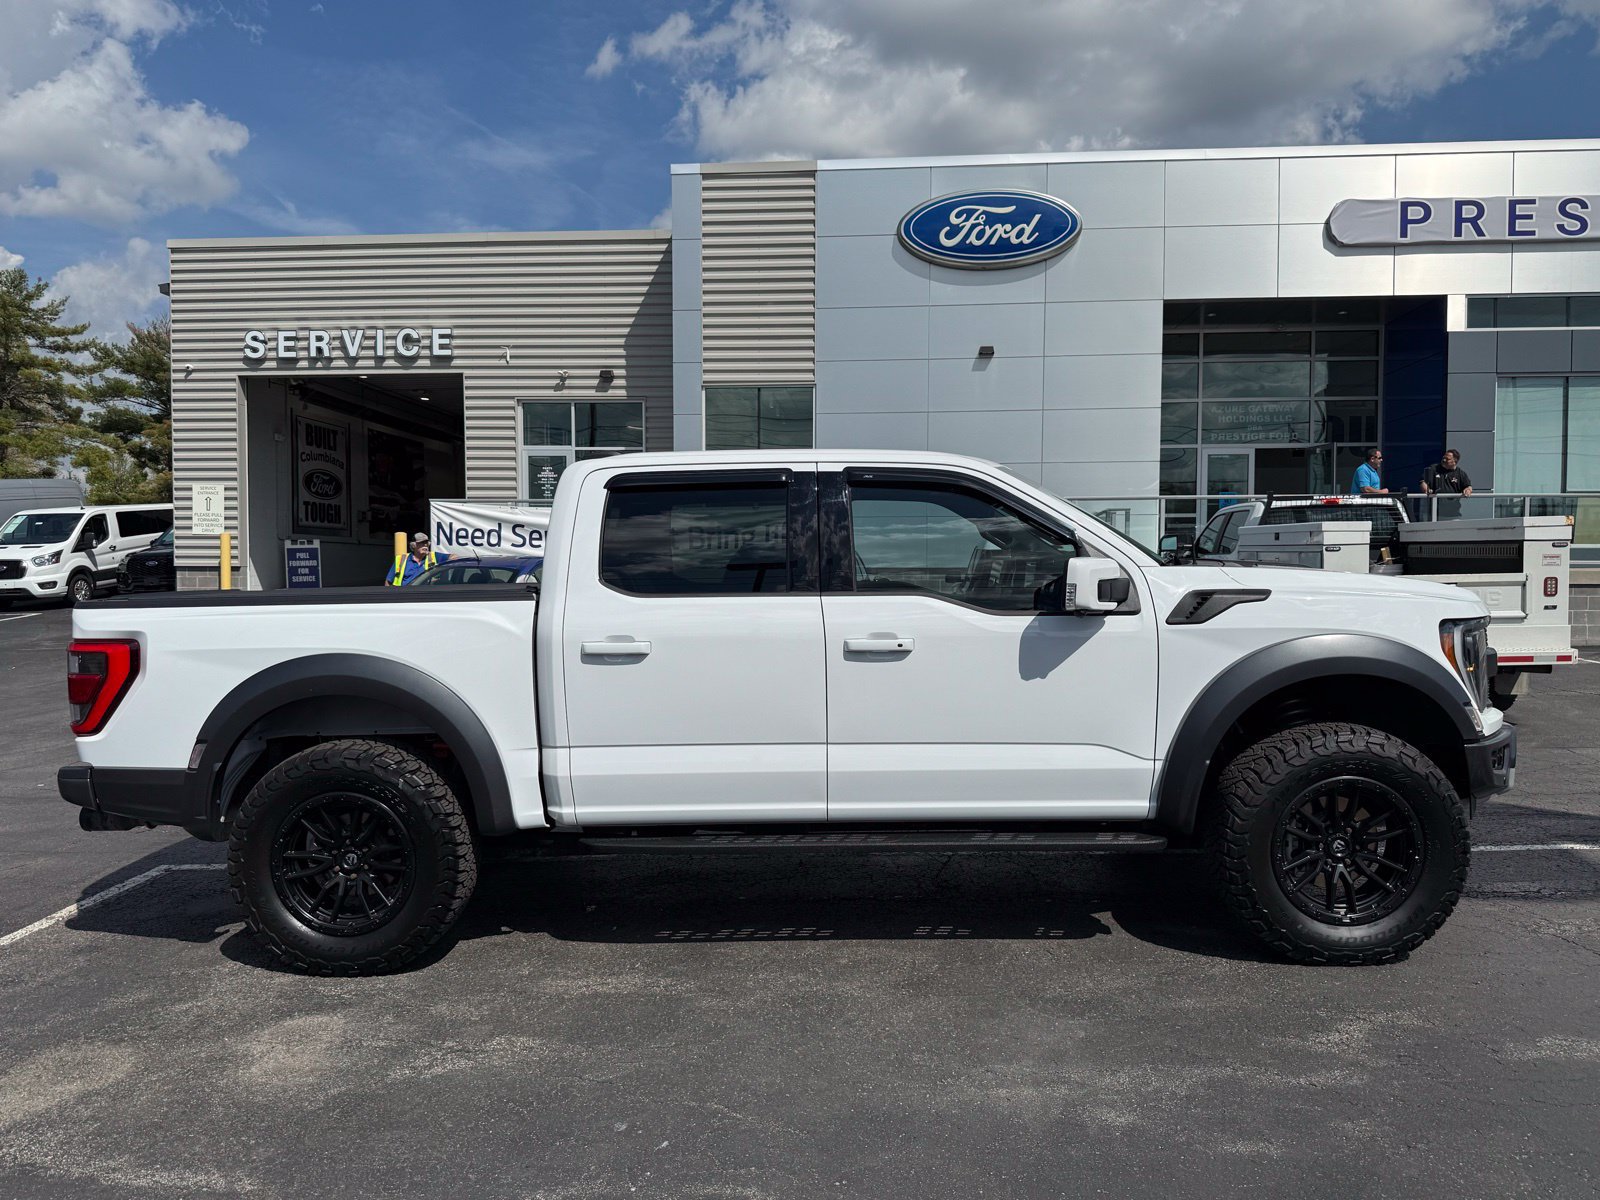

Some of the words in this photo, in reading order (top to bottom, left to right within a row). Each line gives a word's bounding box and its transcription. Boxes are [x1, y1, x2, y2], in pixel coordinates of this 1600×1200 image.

[939, 205, 1041, 247] Ford
[1398, 196, 1591, 239] PRES
[244, 327, 453, 359] SERVICE
[1211, 405, 1245, 413] AZURE
[1248, 403, 1297, 413] GATEWAY
[1217, 414, 1270, 423] HOLDINGS
[1273, 414, 1293, 422] LLC
[305, 423, 338, 452] BUILT
[1211, 432, 1266, 441] PRESTIGE
[1269, 432, 1298, 440] FORD
[300, 450, 345, 470] Columbiana
[310, 473, 336, 495] Ford
[303, 501, 341, 525] TOUGH
[436, 522, 502, 547] Need
[297, 567, 310, 575] FOR
